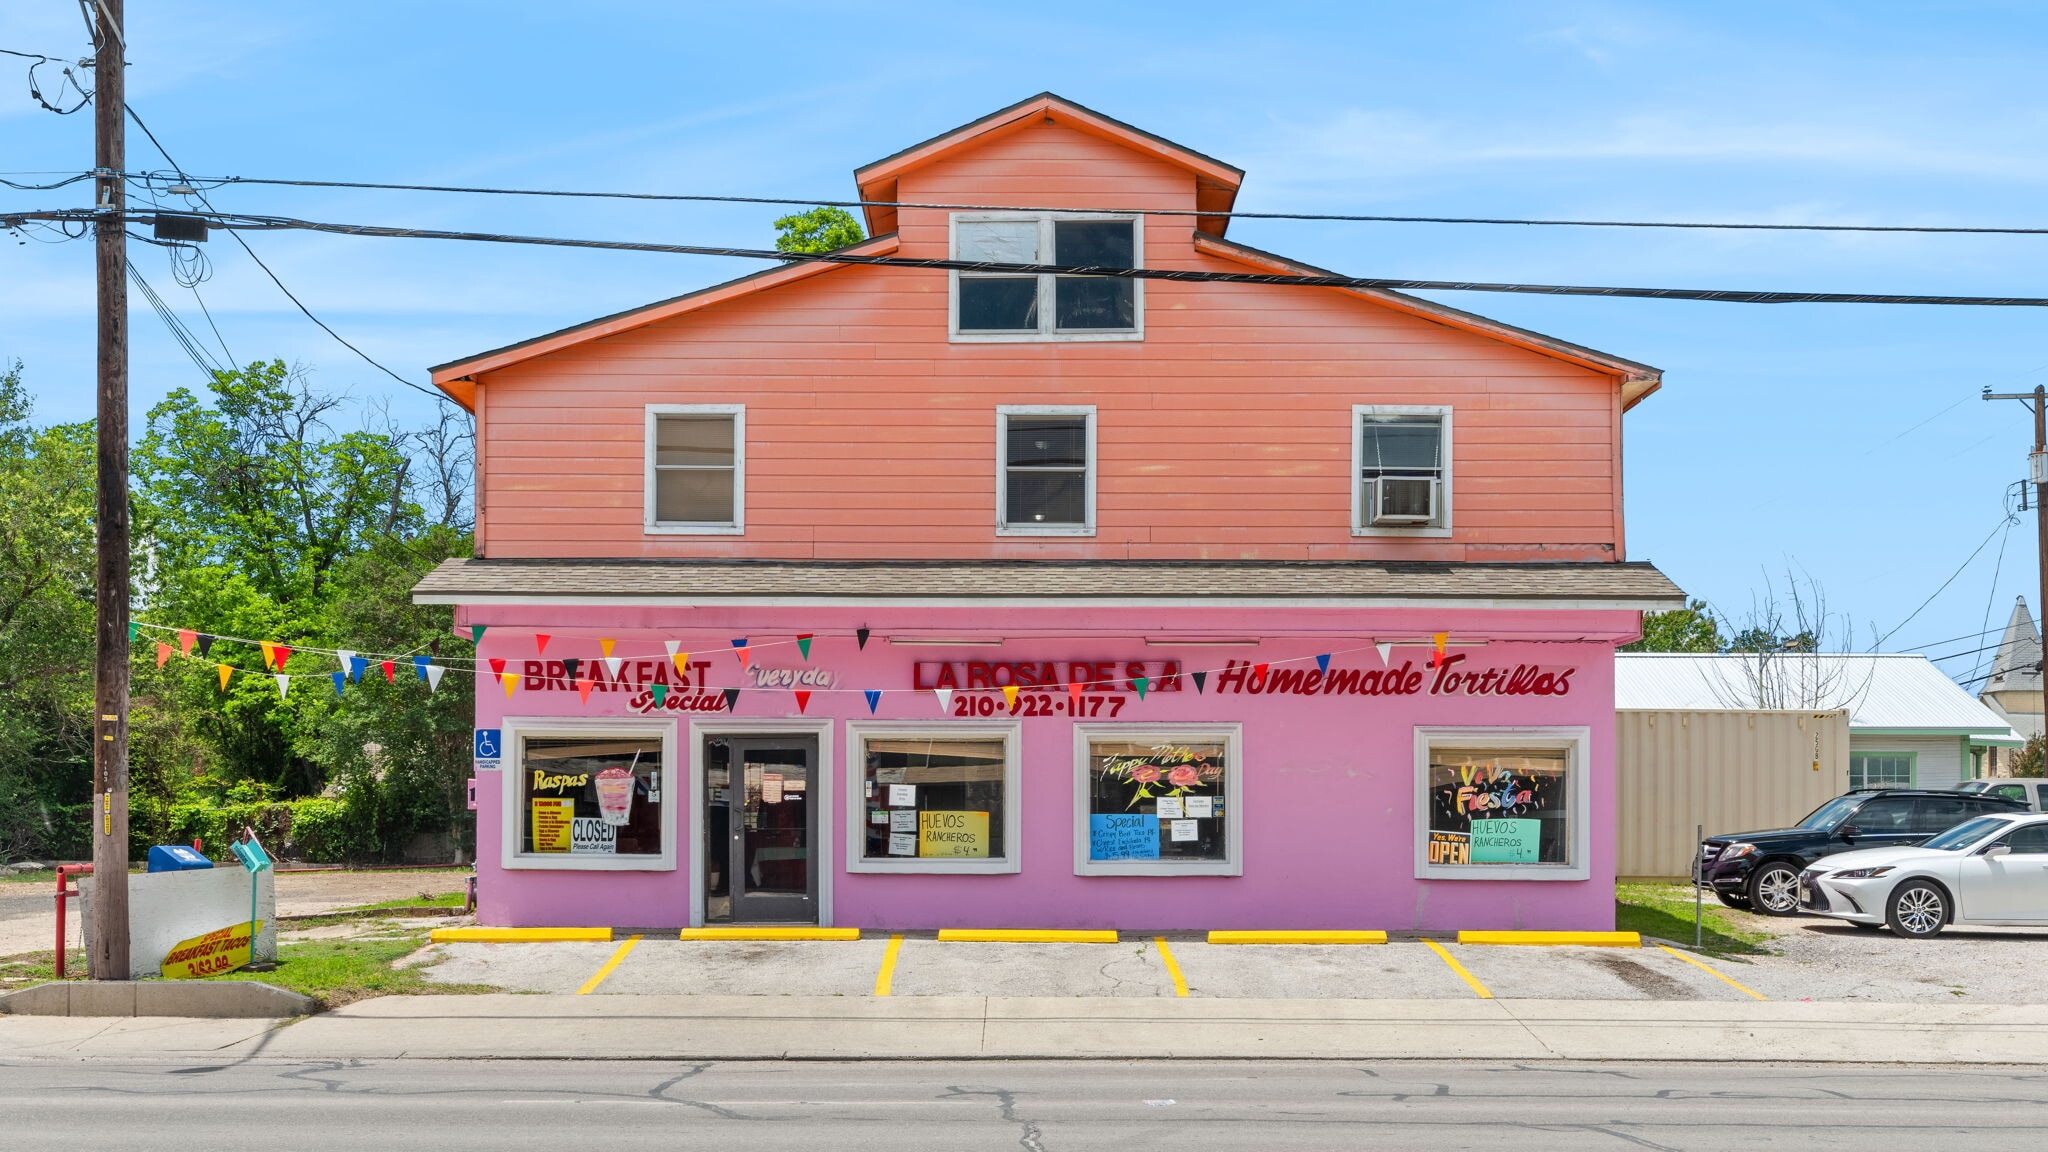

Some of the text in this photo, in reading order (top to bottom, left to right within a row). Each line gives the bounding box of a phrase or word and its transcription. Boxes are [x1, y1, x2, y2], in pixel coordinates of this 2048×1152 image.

[524, 660, 711, 693] BREAKFAST
[913, 662, 959, 691] LA
[967, 662, 1061, 691] ROSA
[1068, 662, 1116, 691] DE
[1216, 654, 1576, 697] Homemade Tortillas
[533, 769, 589, 795] Raspas
[1457, 782, 1532, 815] Fiesta
[572, 819, 615, 842] CLOSED
[921, 813, 965, 829] HUEVOS
[1106, 814, 1145, 831] Special
[1472, 820, 1517, 835] HUEVOS
[926, 830, 976, 843] RANCHEROS
[1473, 836, 1522, 847] RANCHEROS
[1428, 840, 1470, 864] OPEN
